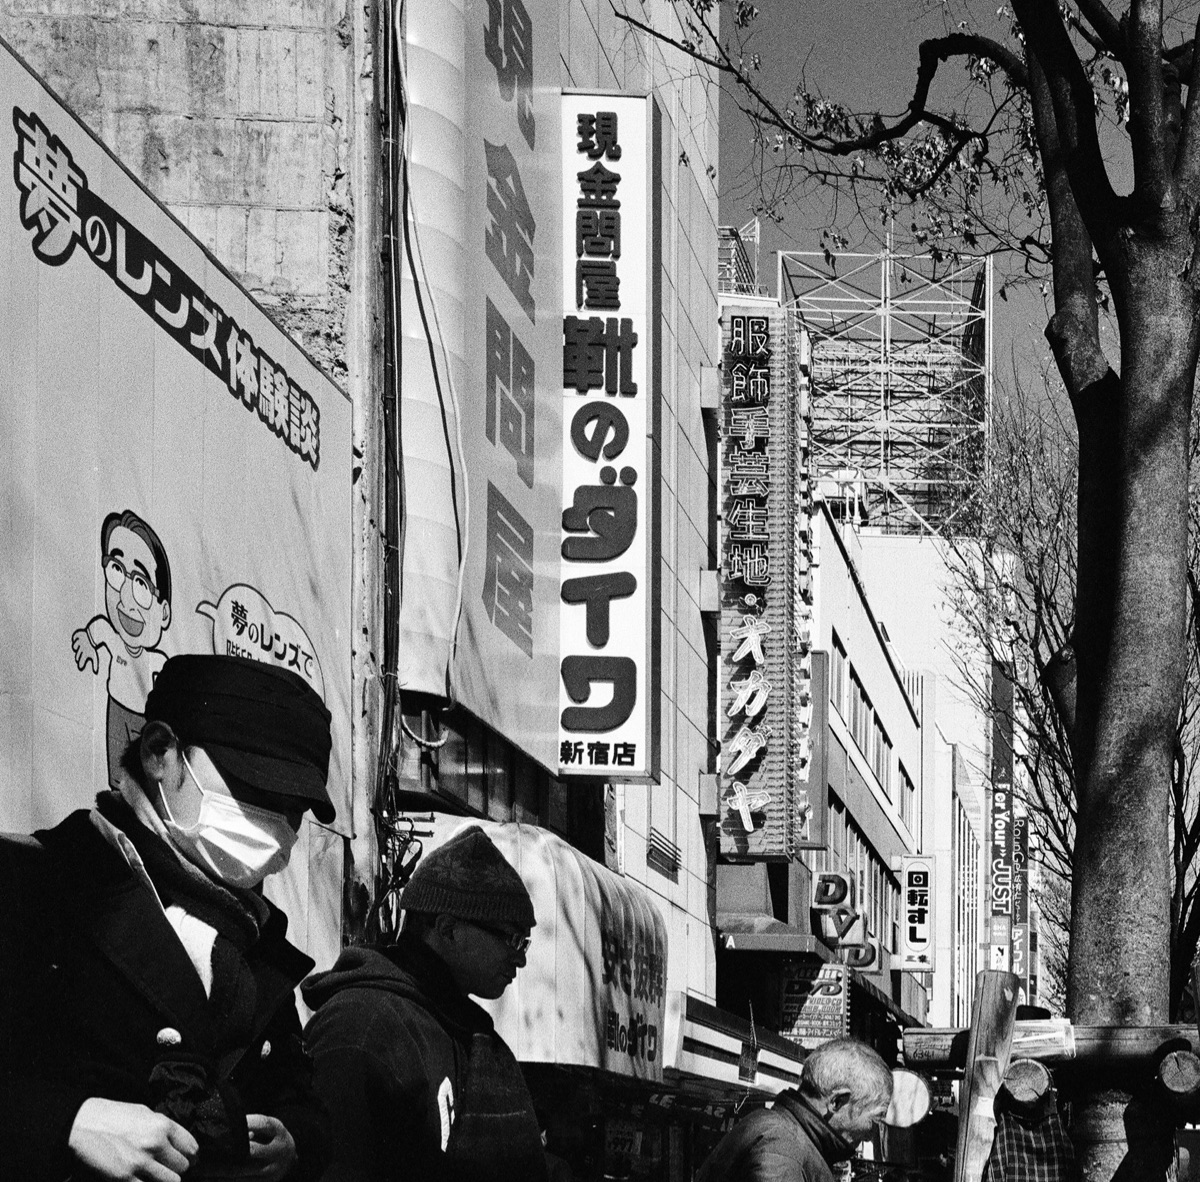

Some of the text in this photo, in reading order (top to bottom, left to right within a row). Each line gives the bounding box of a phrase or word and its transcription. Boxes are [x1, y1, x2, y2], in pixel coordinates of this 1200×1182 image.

[576, 111, 623, 312] 現金問屋
[13, 106, 321, 472] 夢のレンズ体験談
[560, 315, 639, 732] 靴のダイワ
[230, 600, 314, 679] 夢のレンズで
[559, 740, 637, 767] 新宿店
[994, 809, 1011, 846] Your
[815, 873, 877, 968] DVD
[907, 870, 930, 944] 回転すし
[992, 858, 1012, 914] JUST
